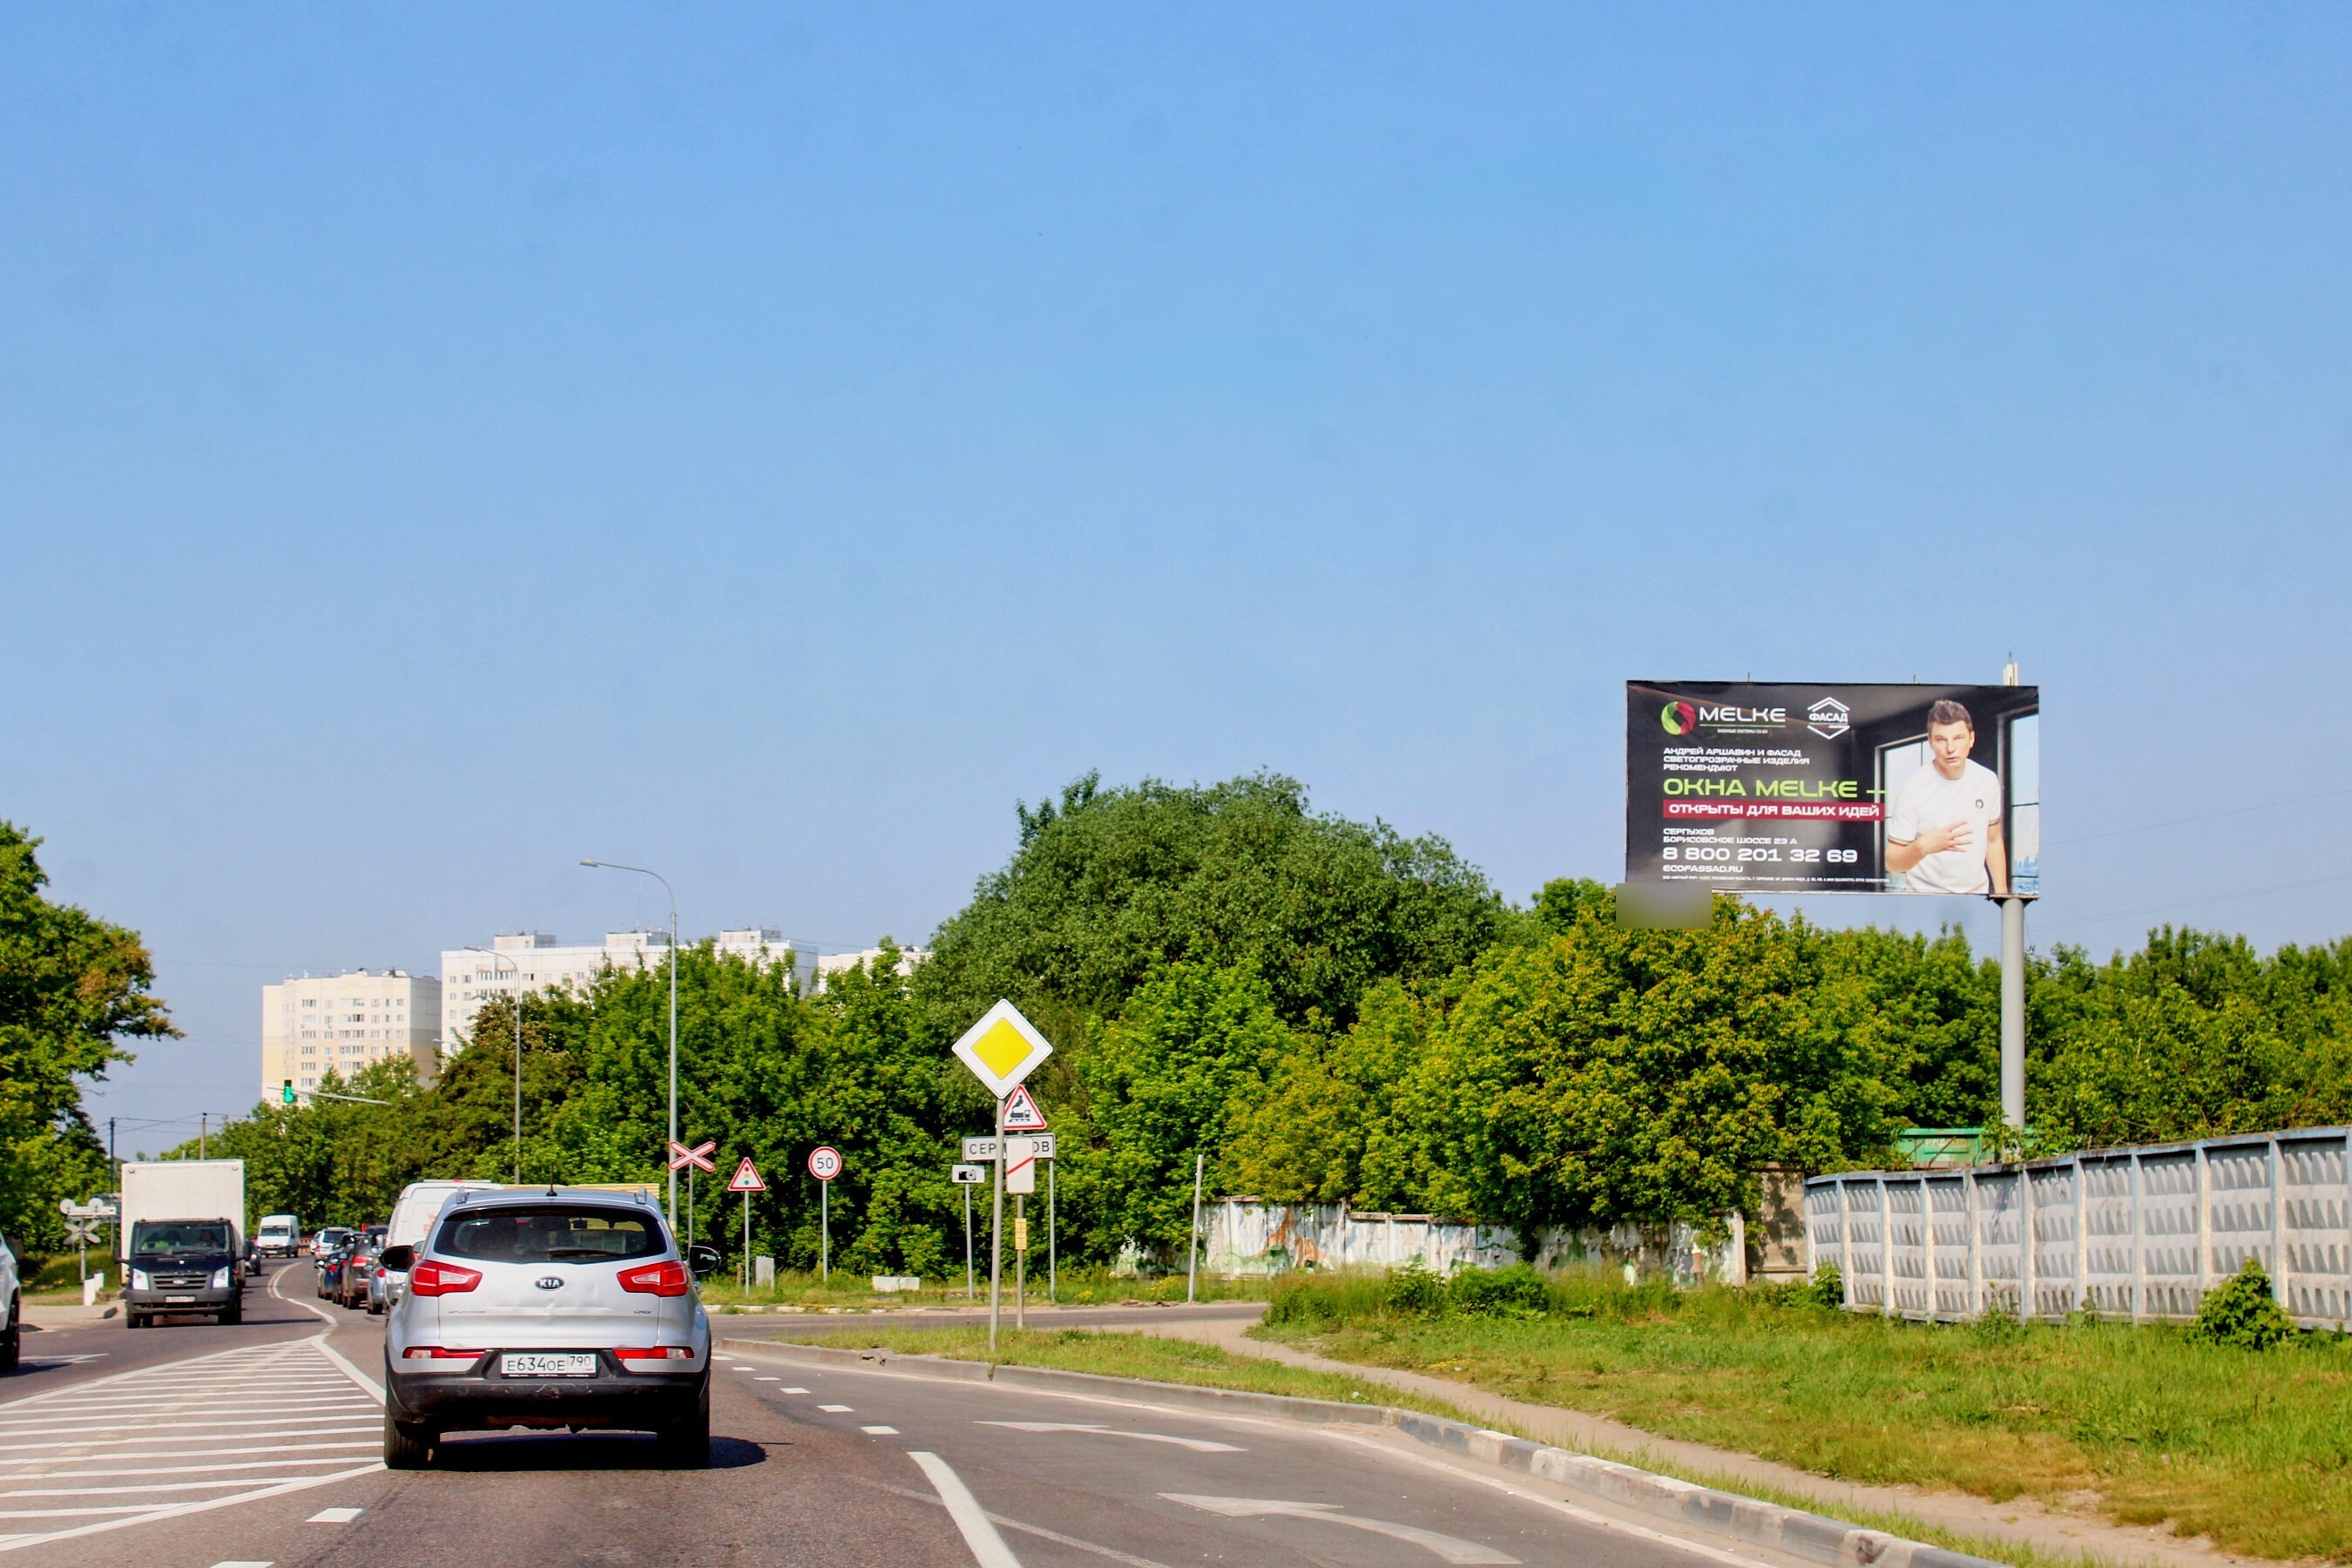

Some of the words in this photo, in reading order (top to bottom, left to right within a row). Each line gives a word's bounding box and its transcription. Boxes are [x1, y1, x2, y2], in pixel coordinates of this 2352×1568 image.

[1699, 706, 1786, 722] MELKE
[1808, 713, 1848, 723] ФАСАД
[1663, 747, 1704, 756] АНДРЕЙ
[1663, 756, 1761, 765] СВЕТОПРОЗРАЧНЫЕ
[1763, 757, 1810, 766] ИЗДЕЛИЯ
[1663, 763, 1739, 773] РЕКОМЕНДУЮТ
[1663, 778, 1747, 796] ОКНА
[1755, 781, 1858, 798] MELKE
[1669, 803, 1744, 815] ОТКРЫТЫ
[1747, 805, 1778, 816] ДЛЯ
[1781, 805, 1836, 816] ВАШИХ
[1838, 805, 1880, 819] ИДЕЙ
[1662, 847, 1679, 861] 8
[1685, 848, 1731, 862] 800
[1737, 848, 1782, 862] 201
[1789, 848, 1821, 862] 32
[1826, 849, 1858, 863] 69
[969, 1141, 1051, 1155] СЕРОВ
[816, 1157, 834, 1169] 50
[539, 1279, 560, 1288] KIA
[507, 1357, 565, 1371] Е634ОЕ
[569, 1355, 591, 1368] 790
